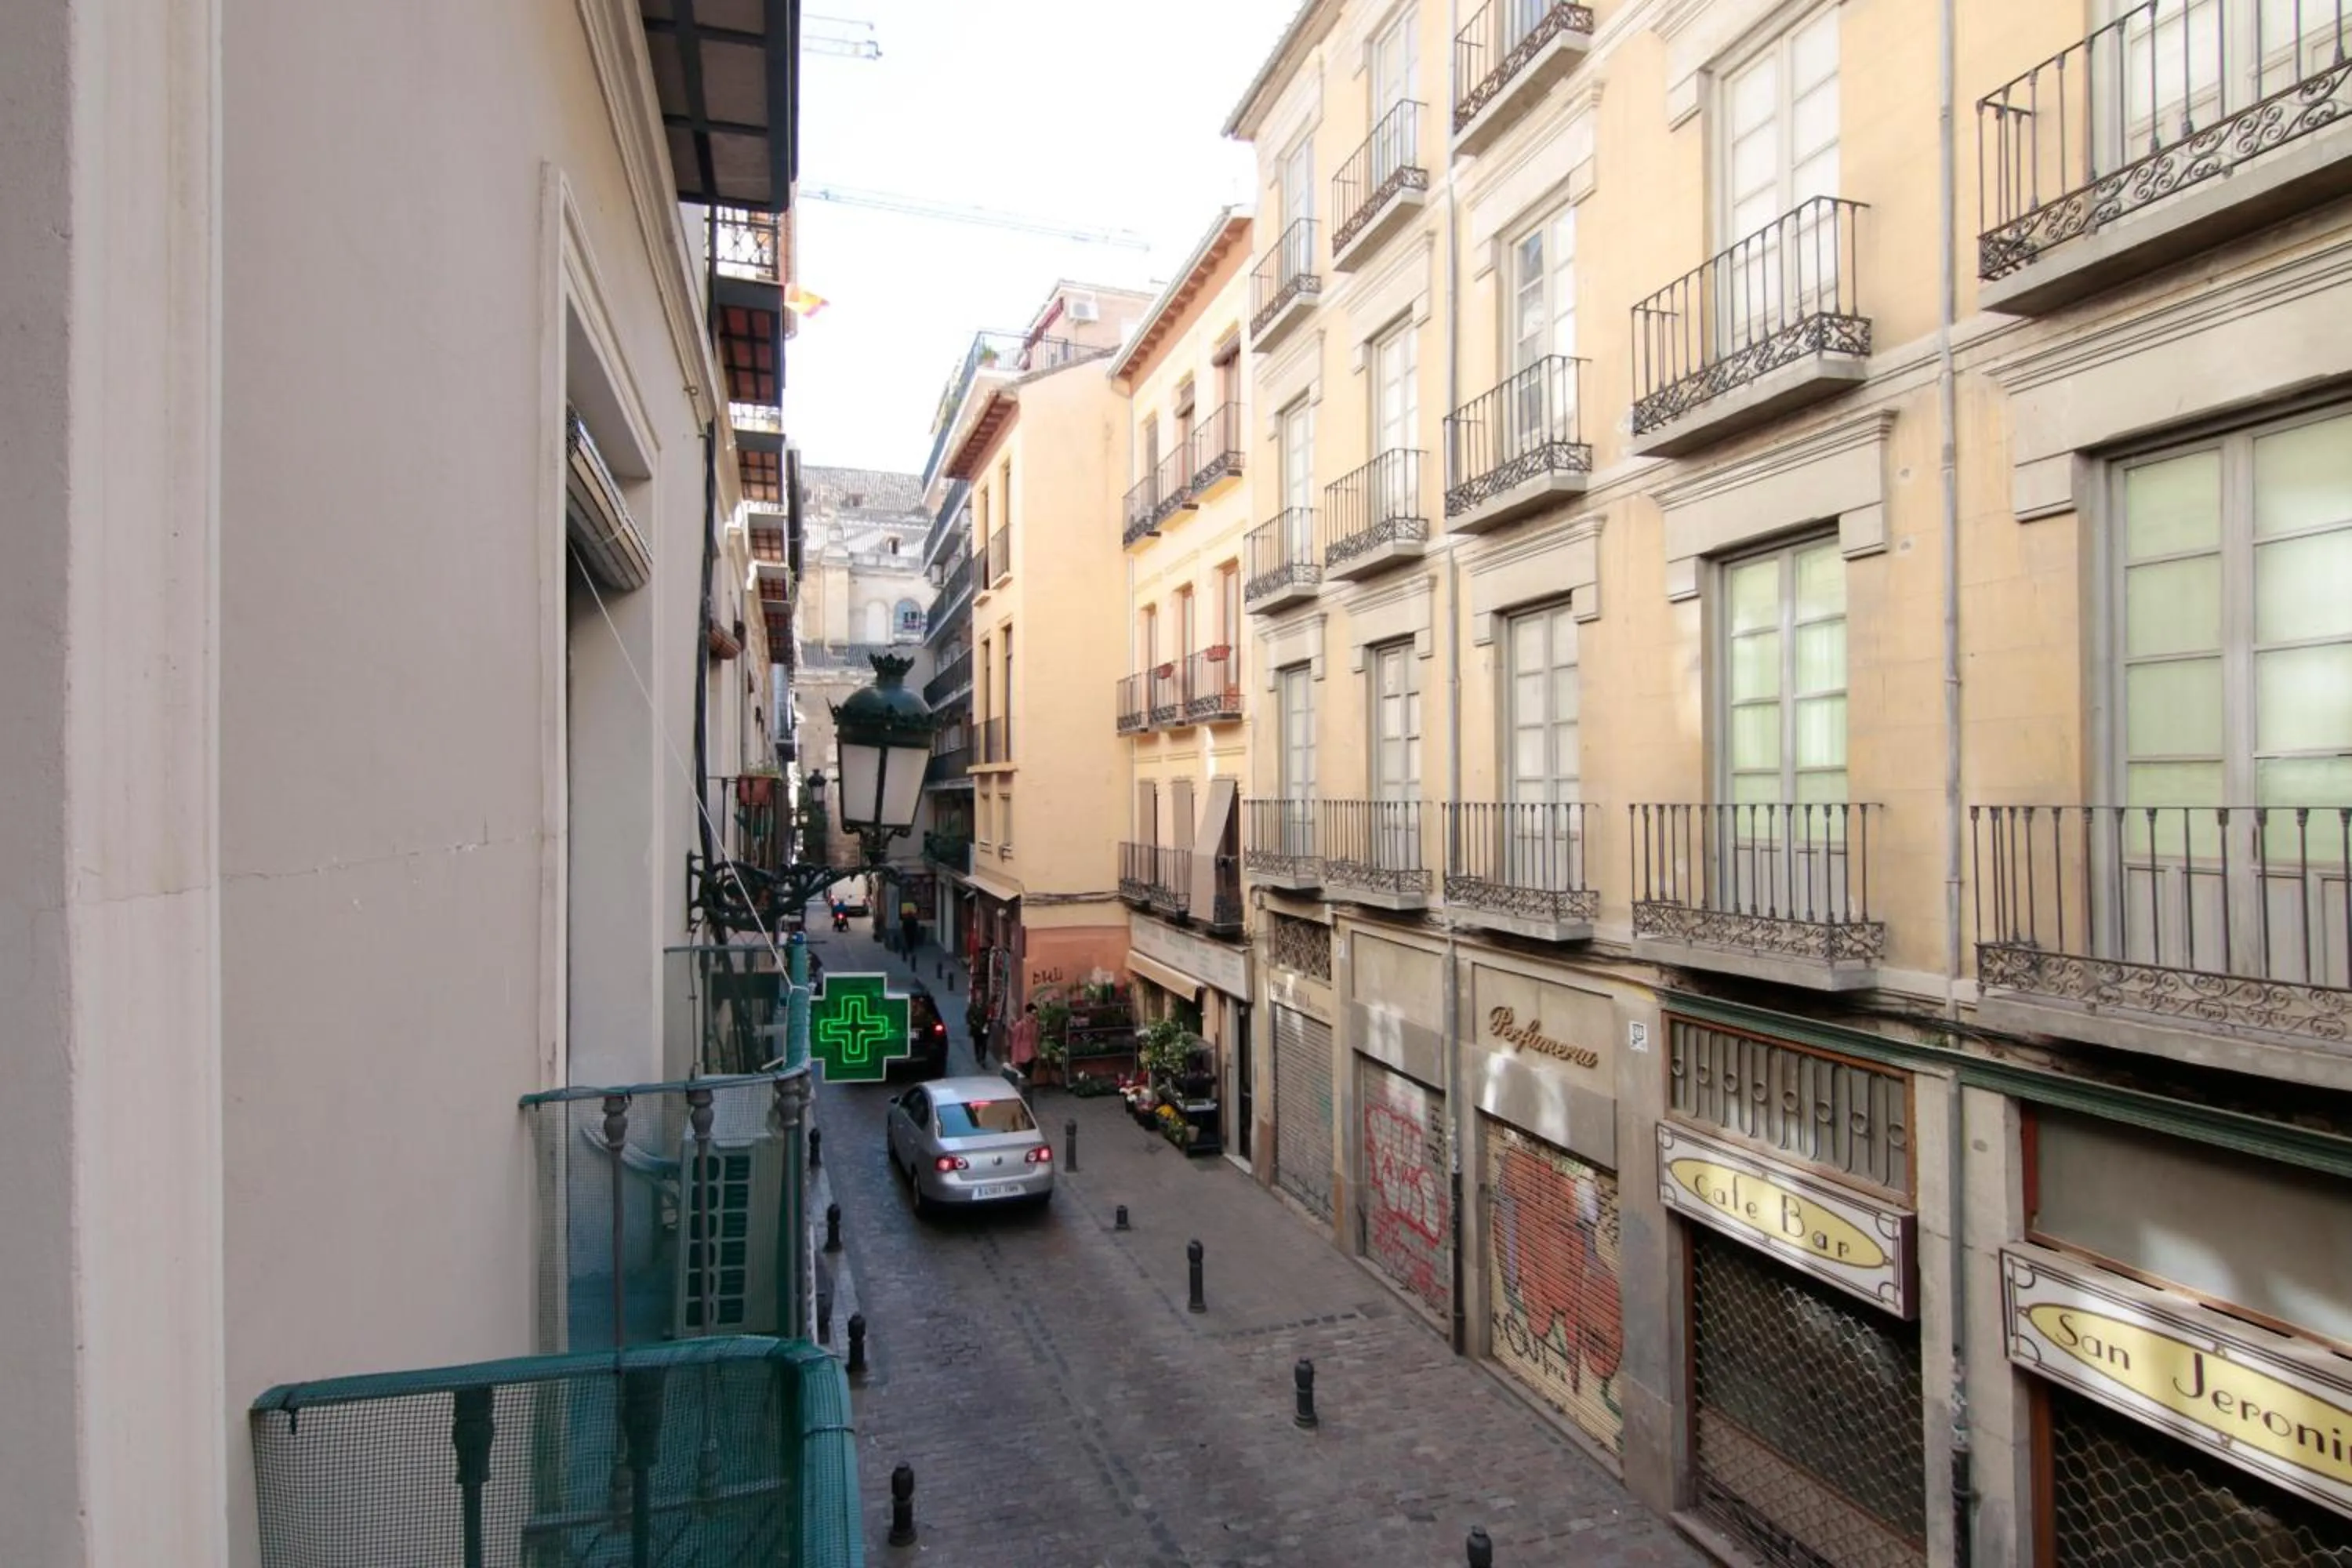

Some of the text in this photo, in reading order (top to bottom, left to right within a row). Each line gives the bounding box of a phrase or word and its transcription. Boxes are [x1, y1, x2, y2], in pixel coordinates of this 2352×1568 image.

[1781, 1193, 1850, 1258] Bar
[2055, 1313, 2352, 1471] San Jeroni
